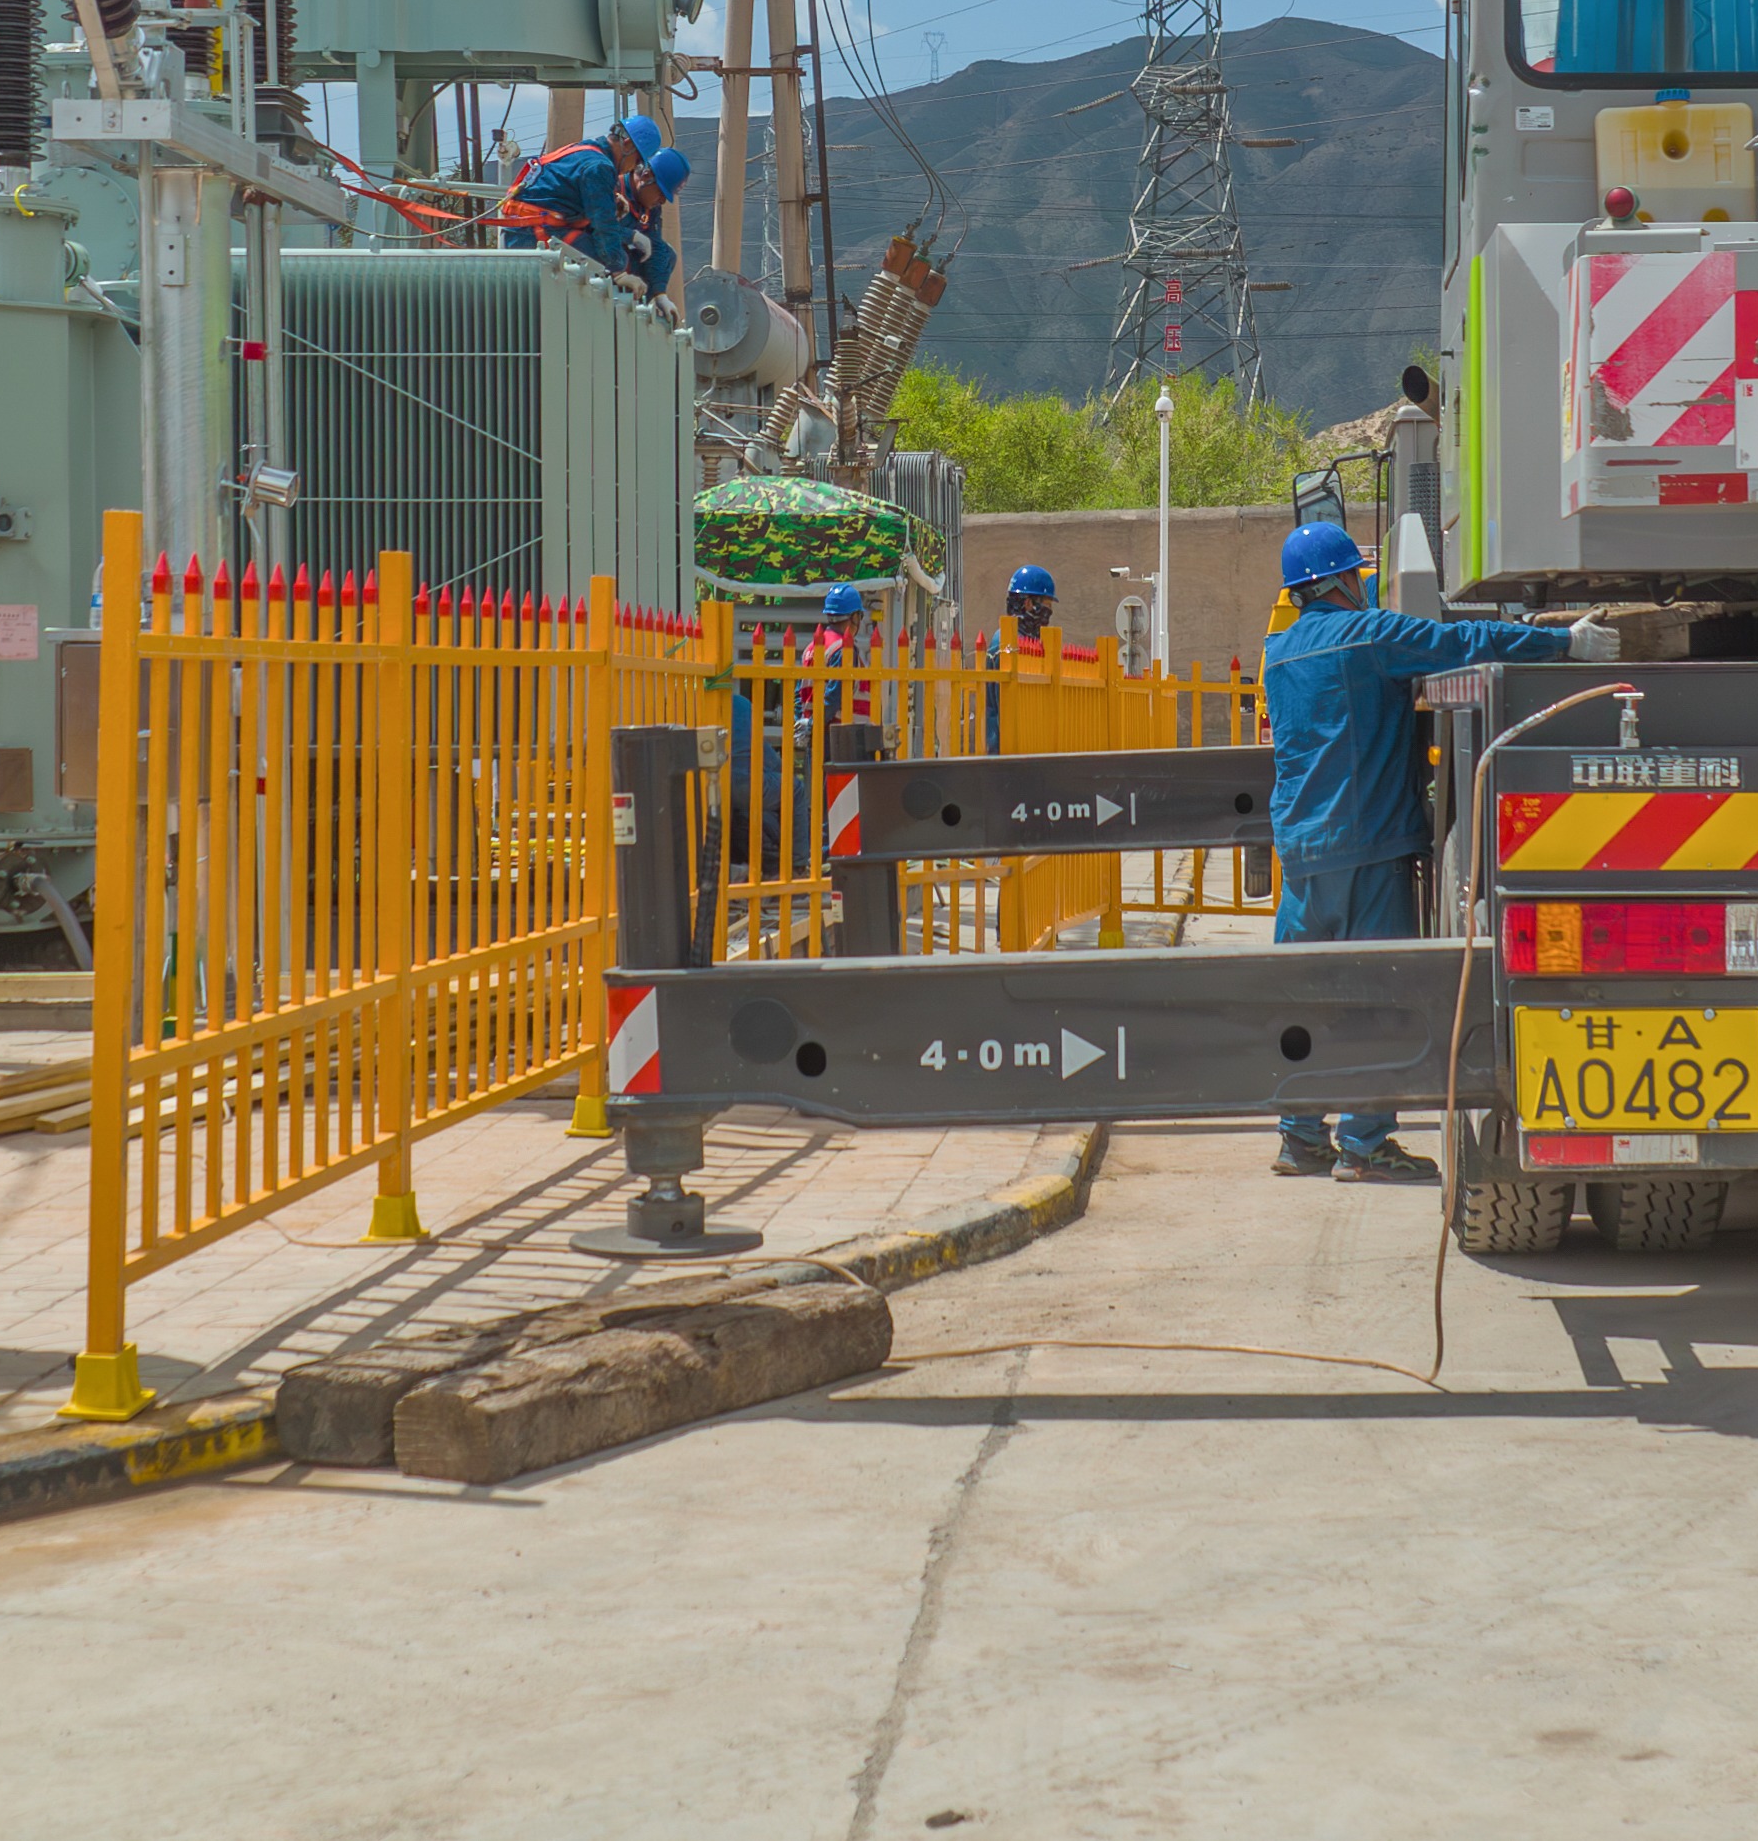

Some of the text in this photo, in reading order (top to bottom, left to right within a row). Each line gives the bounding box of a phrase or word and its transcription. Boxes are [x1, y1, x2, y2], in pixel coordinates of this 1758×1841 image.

[1163, 279, 1183, 353] 高压
[1571, 755, 1742, 788] 中联重科
[1534, 1057, 1752, 1121] A0482
